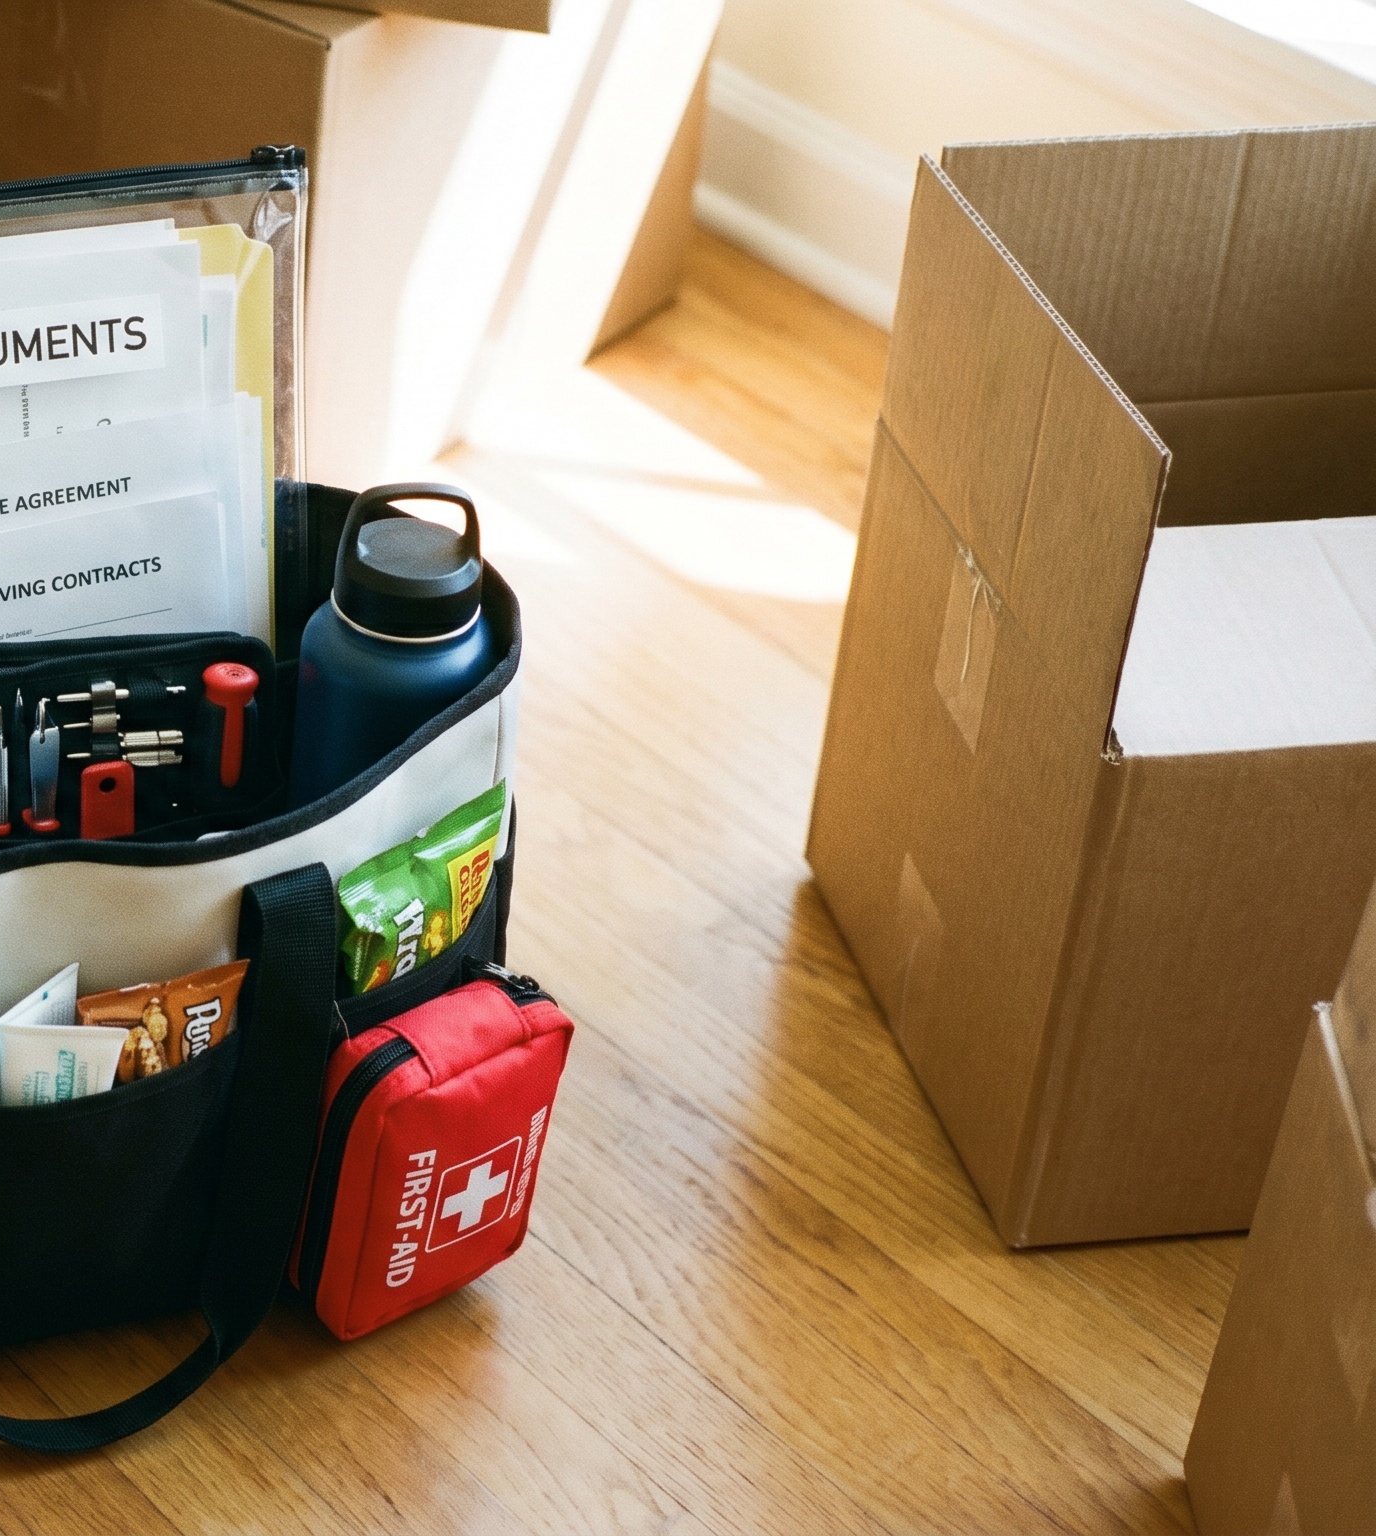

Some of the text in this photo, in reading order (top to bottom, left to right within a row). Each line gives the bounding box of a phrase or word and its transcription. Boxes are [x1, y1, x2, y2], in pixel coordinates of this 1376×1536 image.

[15, 476, 132, 512] AGREEMENT
[51, 556, 162, 592] CONTRACTS
[385, 1149, 437, 1288] FIRST-AID
